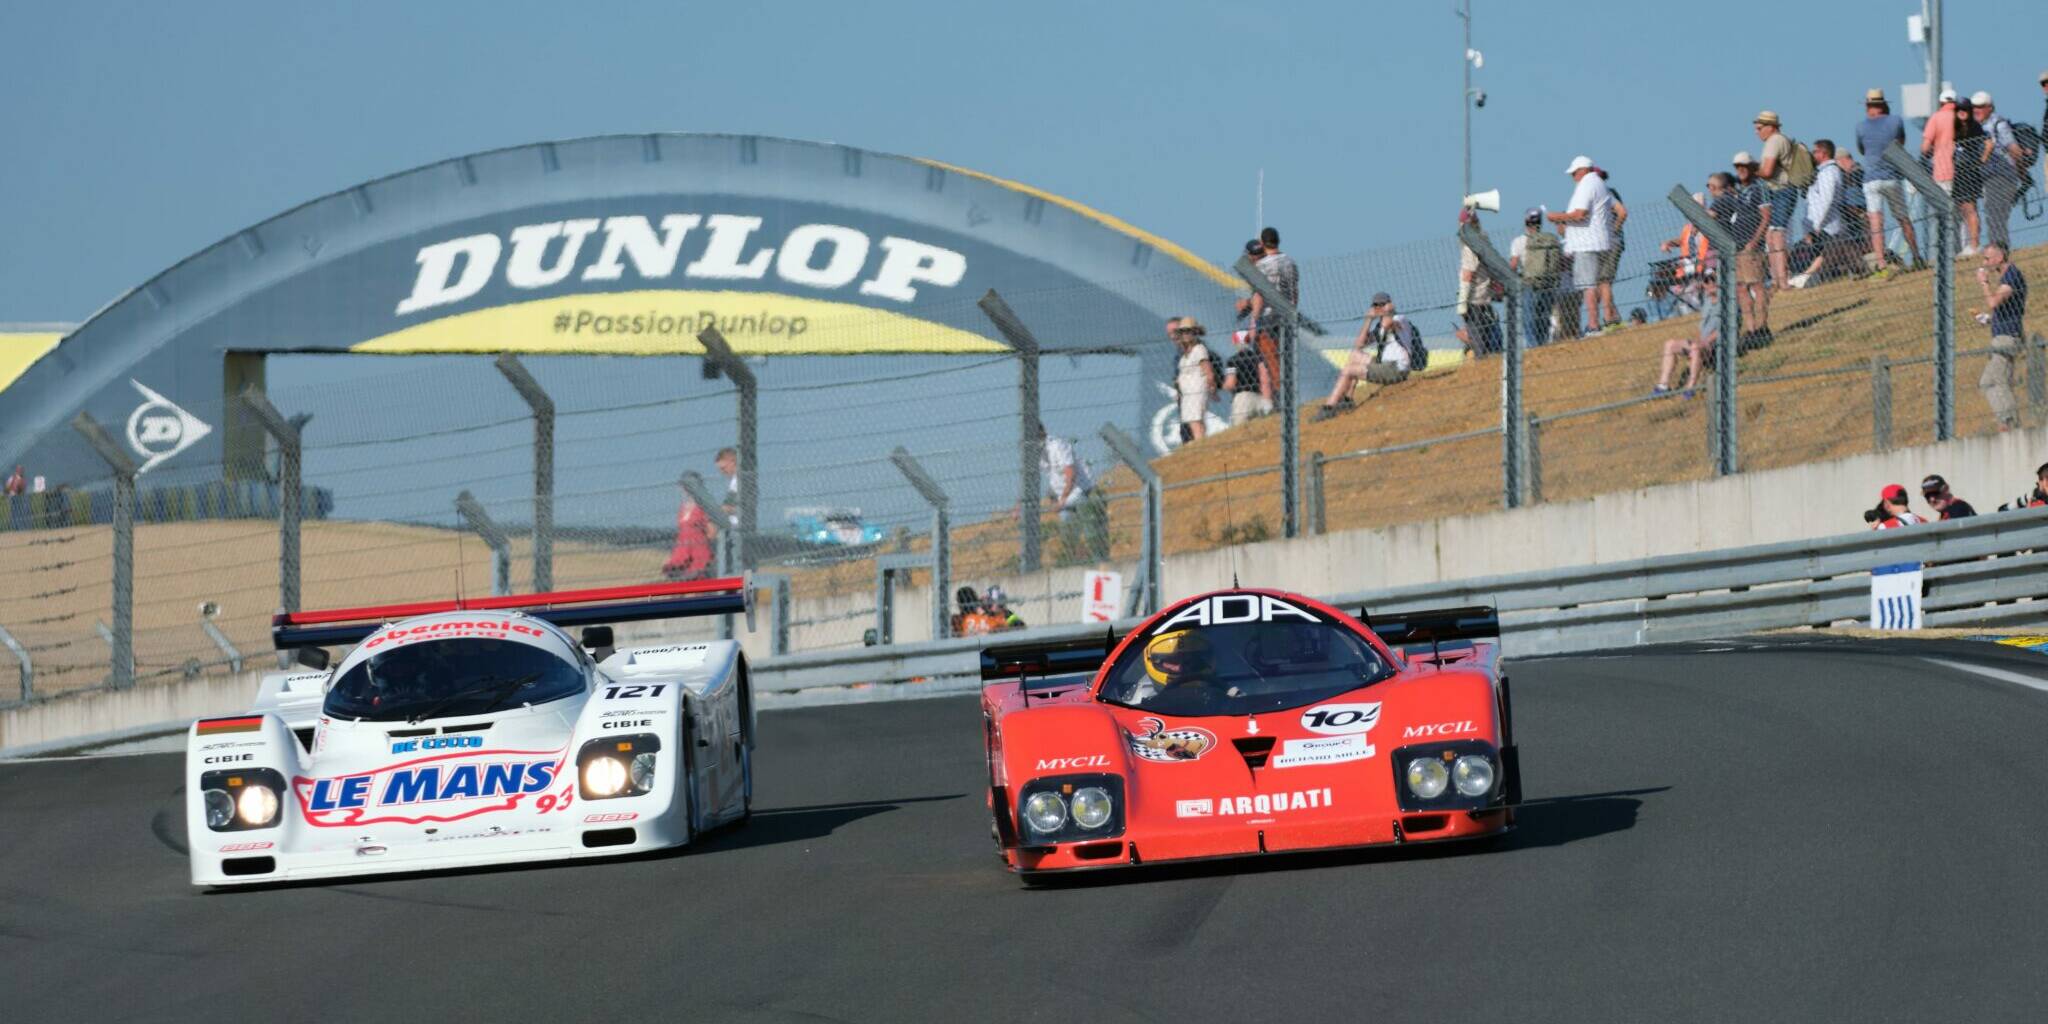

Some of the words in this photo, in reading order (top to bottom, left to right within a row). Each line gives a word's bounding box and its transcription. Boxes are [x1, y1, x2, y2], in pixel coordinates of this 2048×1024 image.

[396, 214, 967, 315] DUNLOP
[1152, 594, 1322, 636] ADA
[366, 621, 544, 648] obermaier
[604, 684, 667, 700] 121
[602, 719, 653, 729] CIBIE
[1403, 720, 1478, 738] MYCIL
[204, 753, 254, 764] CIBIE
[1035, 755, 1112, 770] MYCIL
[310, 776, 371, 811] LE
[382, 761, 556, 805] MANS
[536, 784, 573, 814] 93
[1218, 788, 1333, 816] ARQUATI
